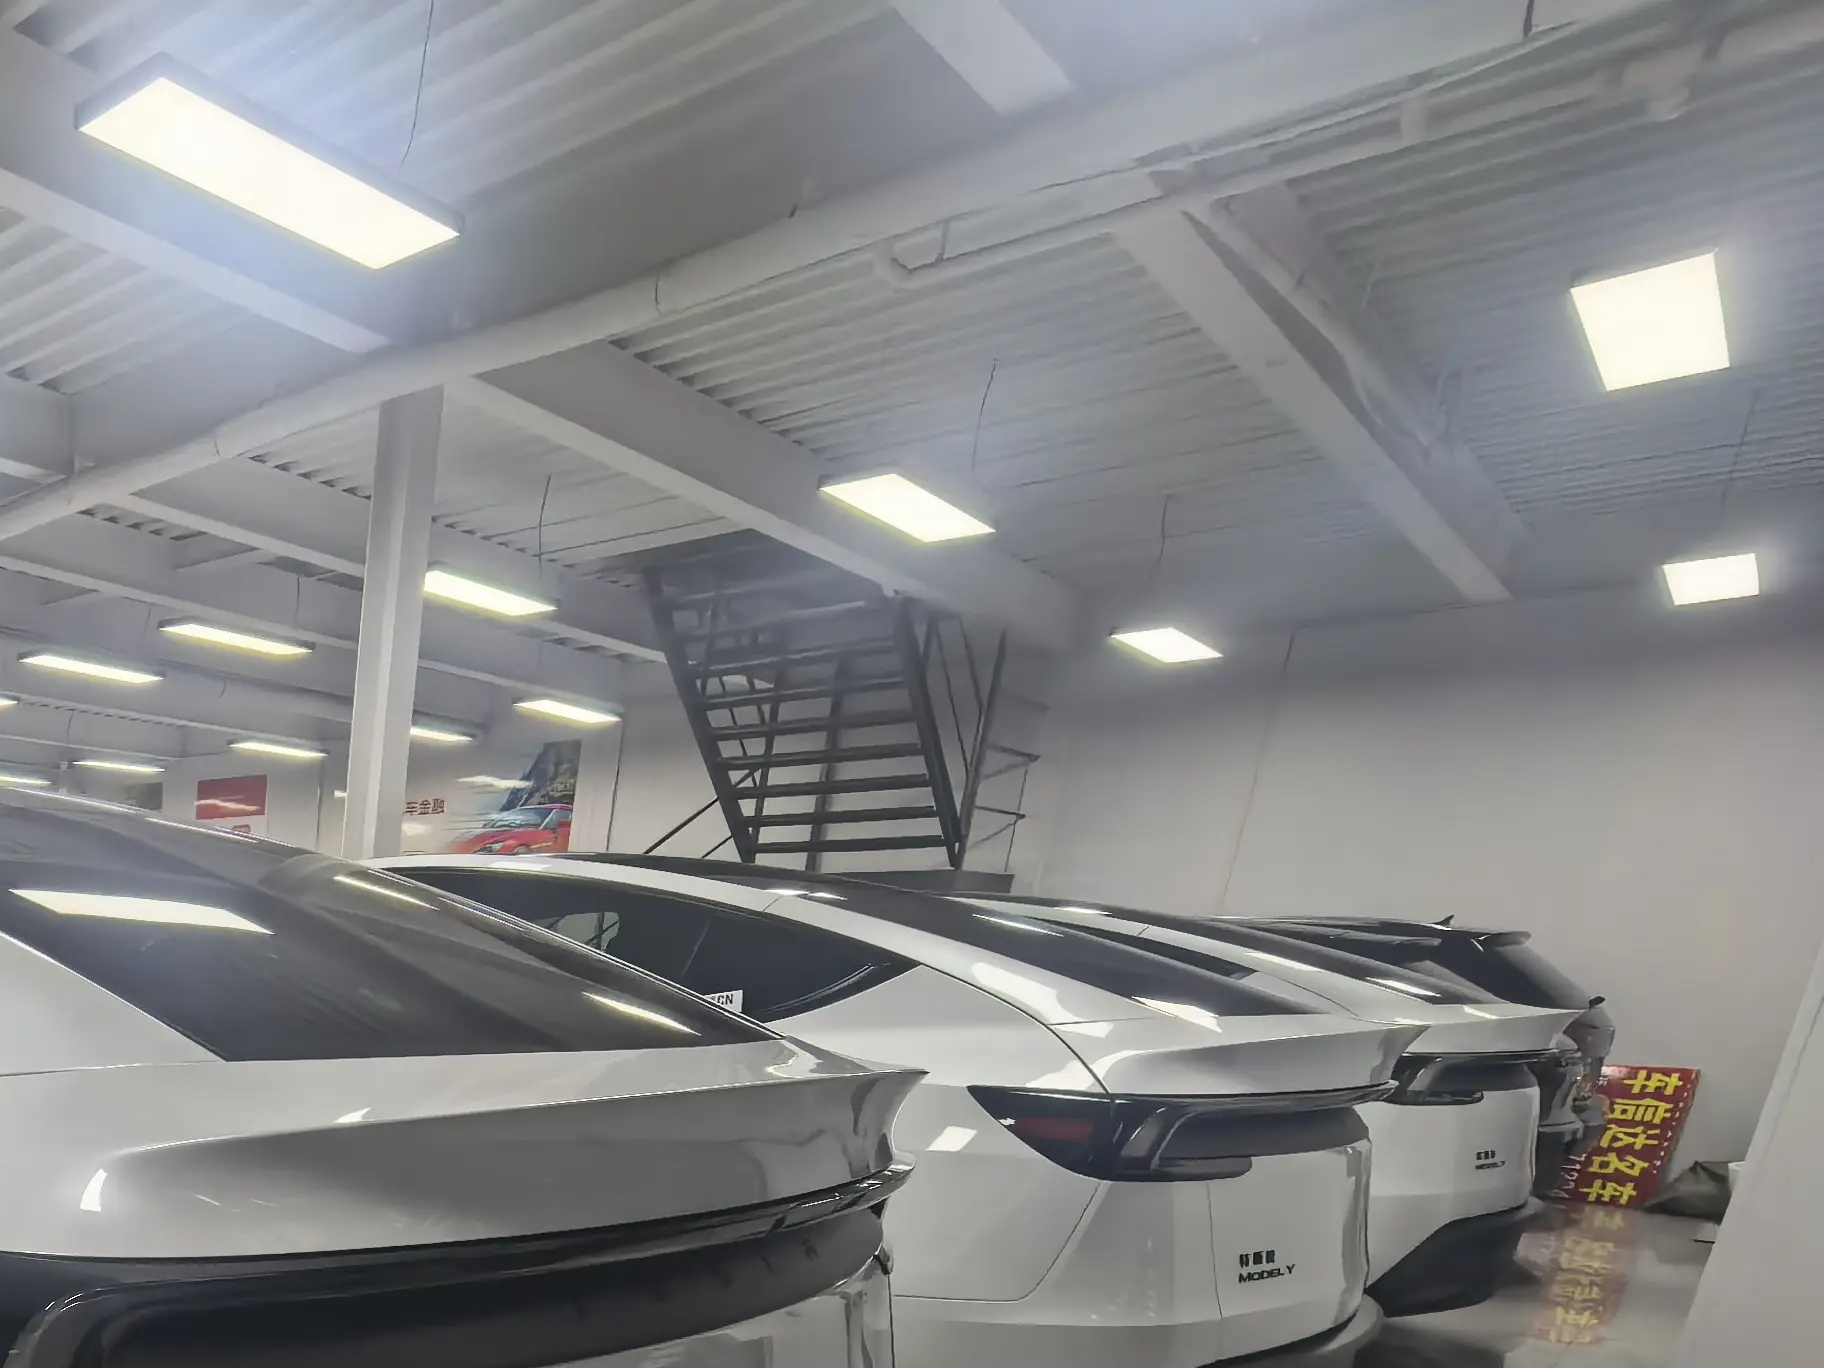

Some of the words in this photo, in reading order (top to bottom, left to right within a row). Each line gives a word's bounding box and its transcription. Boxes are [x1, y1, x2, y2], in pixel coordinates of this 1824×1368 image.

[717, 993, 734, 1005] CN
[1578, 1069, 1684, 1206] 车信达名车
[1238, 1267, 1285, 1284] MODEL
[1286, 1263, 1296, 1275] Y
